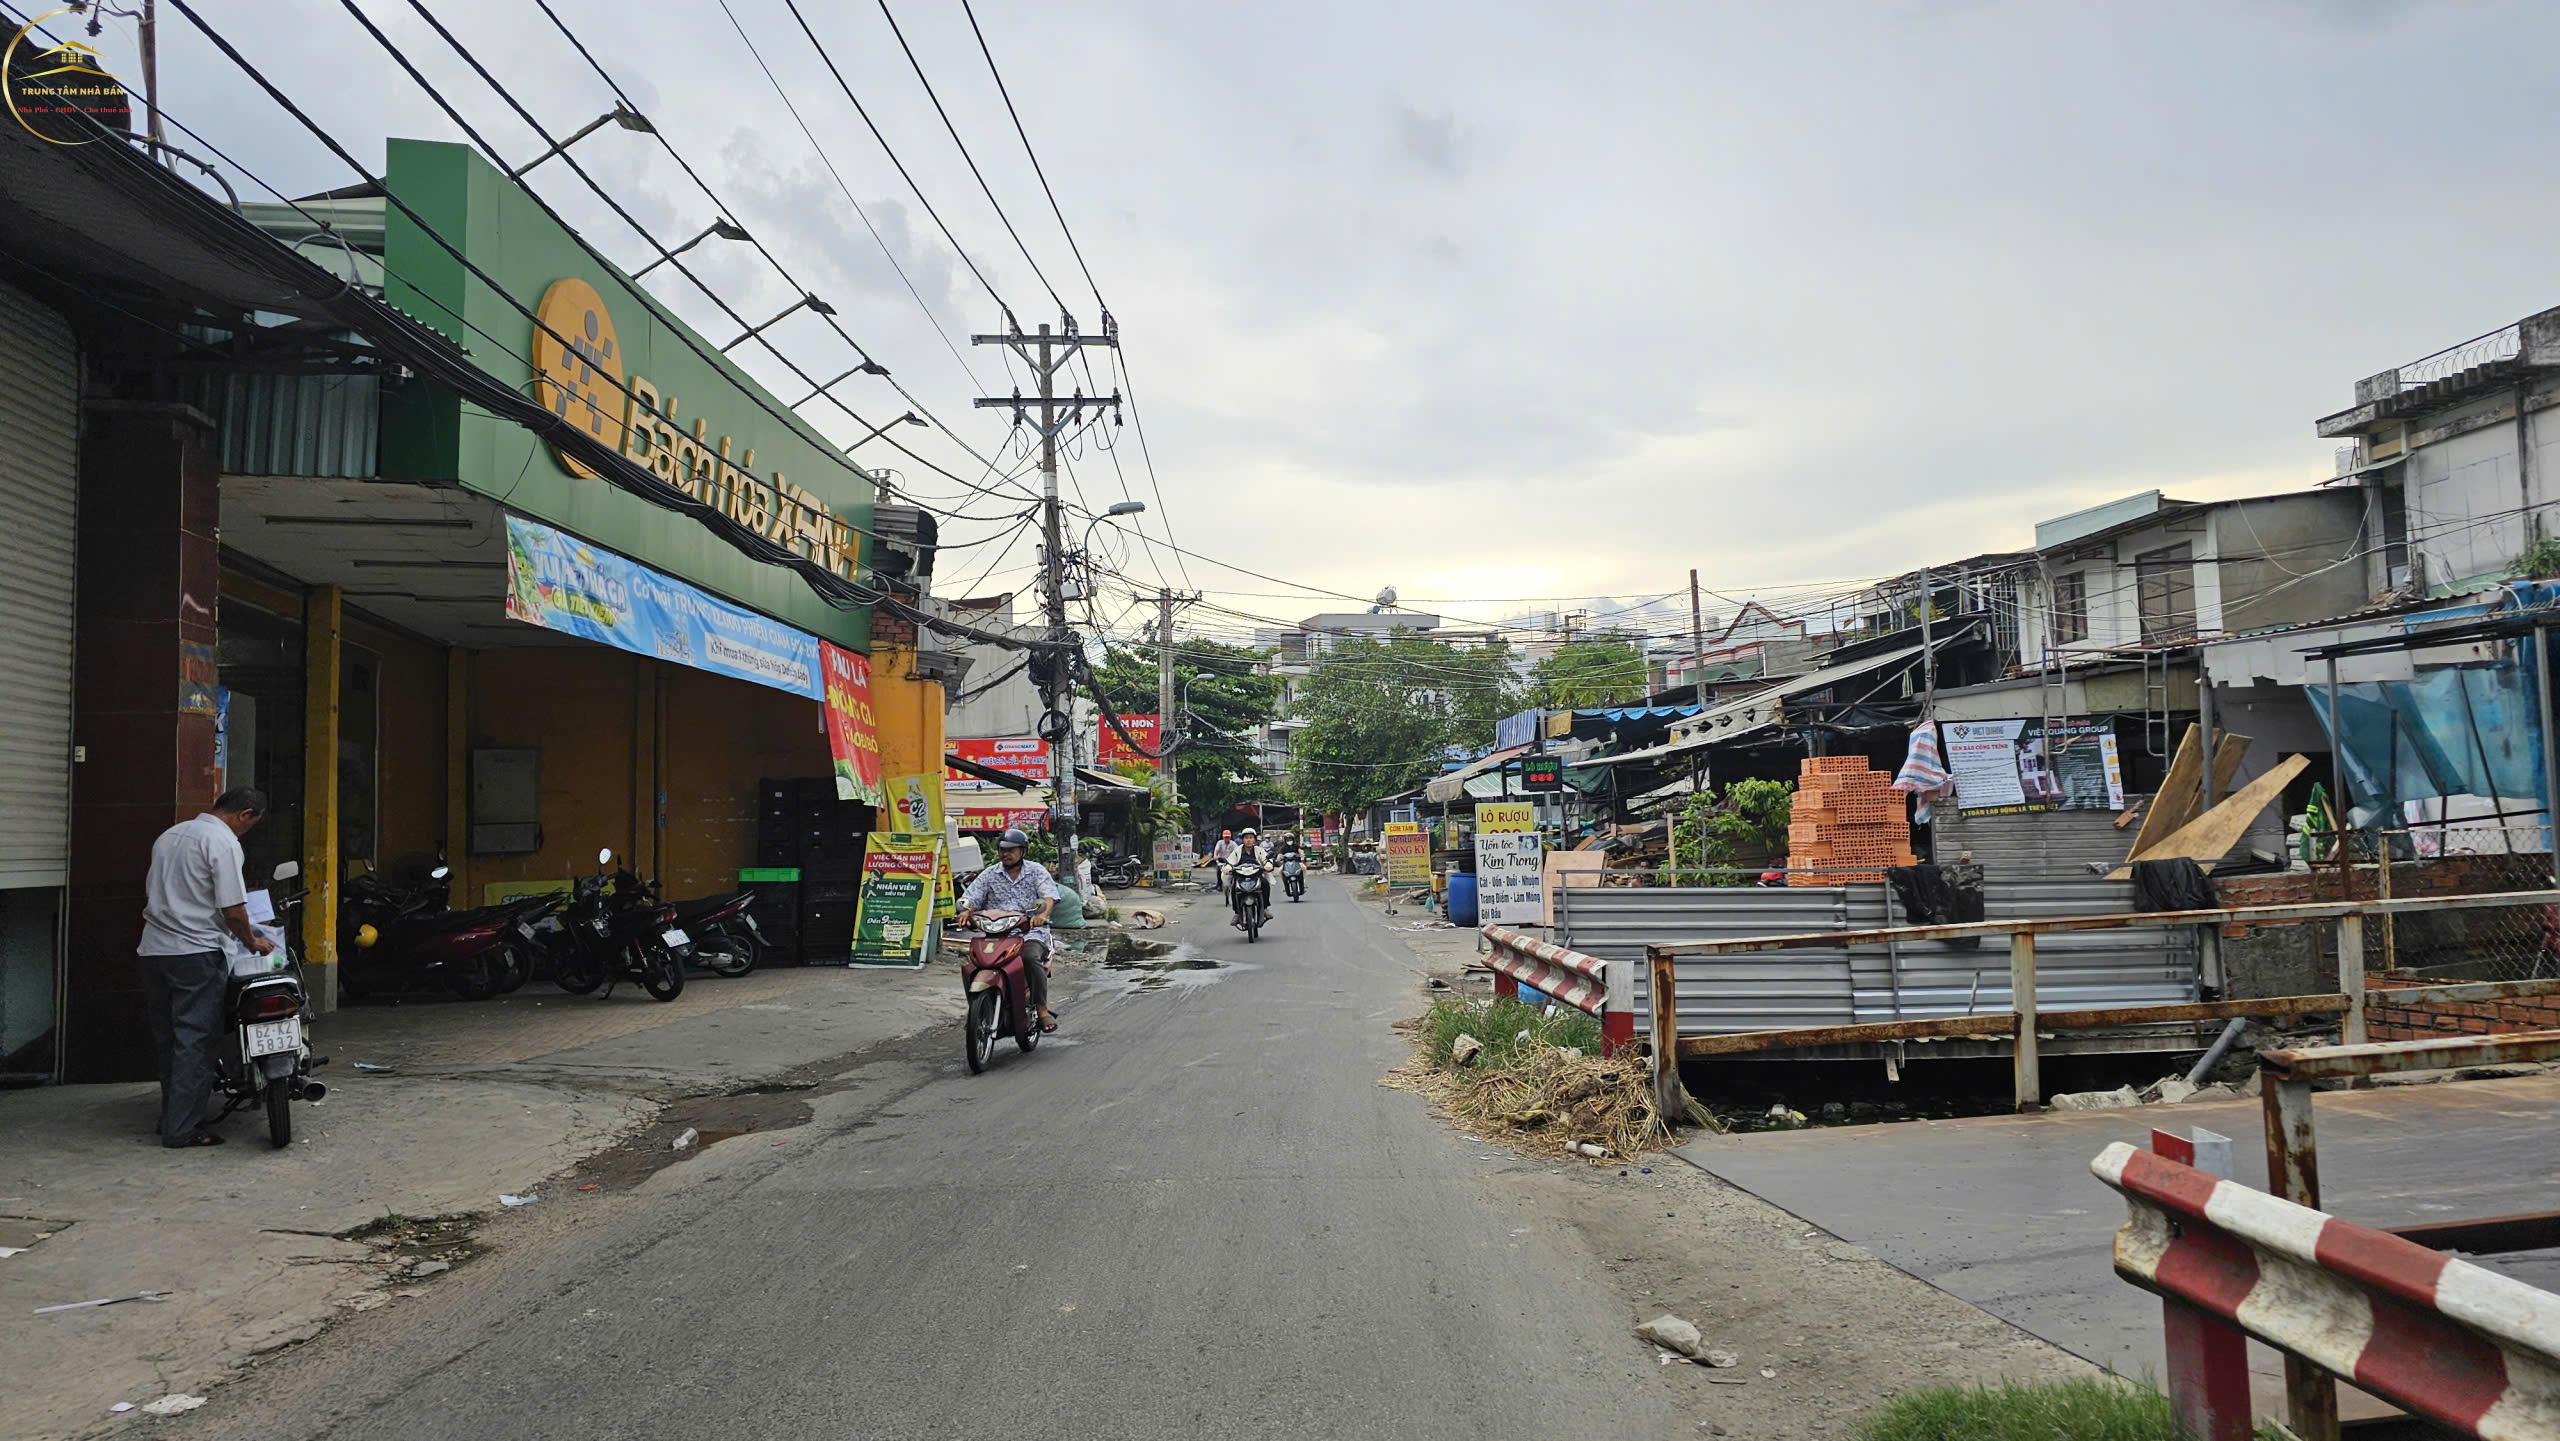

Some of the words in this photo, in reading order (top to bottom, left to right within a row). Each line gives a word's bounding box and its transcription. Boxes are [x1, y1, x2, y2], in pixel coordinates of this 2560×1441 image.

[624, 375, 715, 506] Bách
[717, 435, 770, 536] hóa
[710, 637, 724, 656] Khi
[850, 659, 867, 689] LÁ
[1131, 719, 1155, 728] NON
[2048, 727, 2077, 736] QUANG
[2078, 725, 2109, 734] GROUP
[909, 800, 927, 817] C2
[985, 811, 1005, 829] VŨ
[1481, 810, 1494, 823] LÒ
[1498, 811, 1529, 825] RƯỢU
[1389, 845, 1412, 855] SONG
[1479, 838, 1500, 851] Uốn
[1501, 838, 1514, 850] tóc
[1480, 853, 1506, 870] Kim
[876, 882, 899, 890] NHÂN
[899, 882, 917, 891] VIÊN
[1479, 874, 1489, 888] Cắt
[1480, 893, 1495, 905] Trang
[1513, 891, 1525, 903] Làm
[255, 1021, 293, 1039] 62-K2
[256, 1035, 294, 1053] 5832
